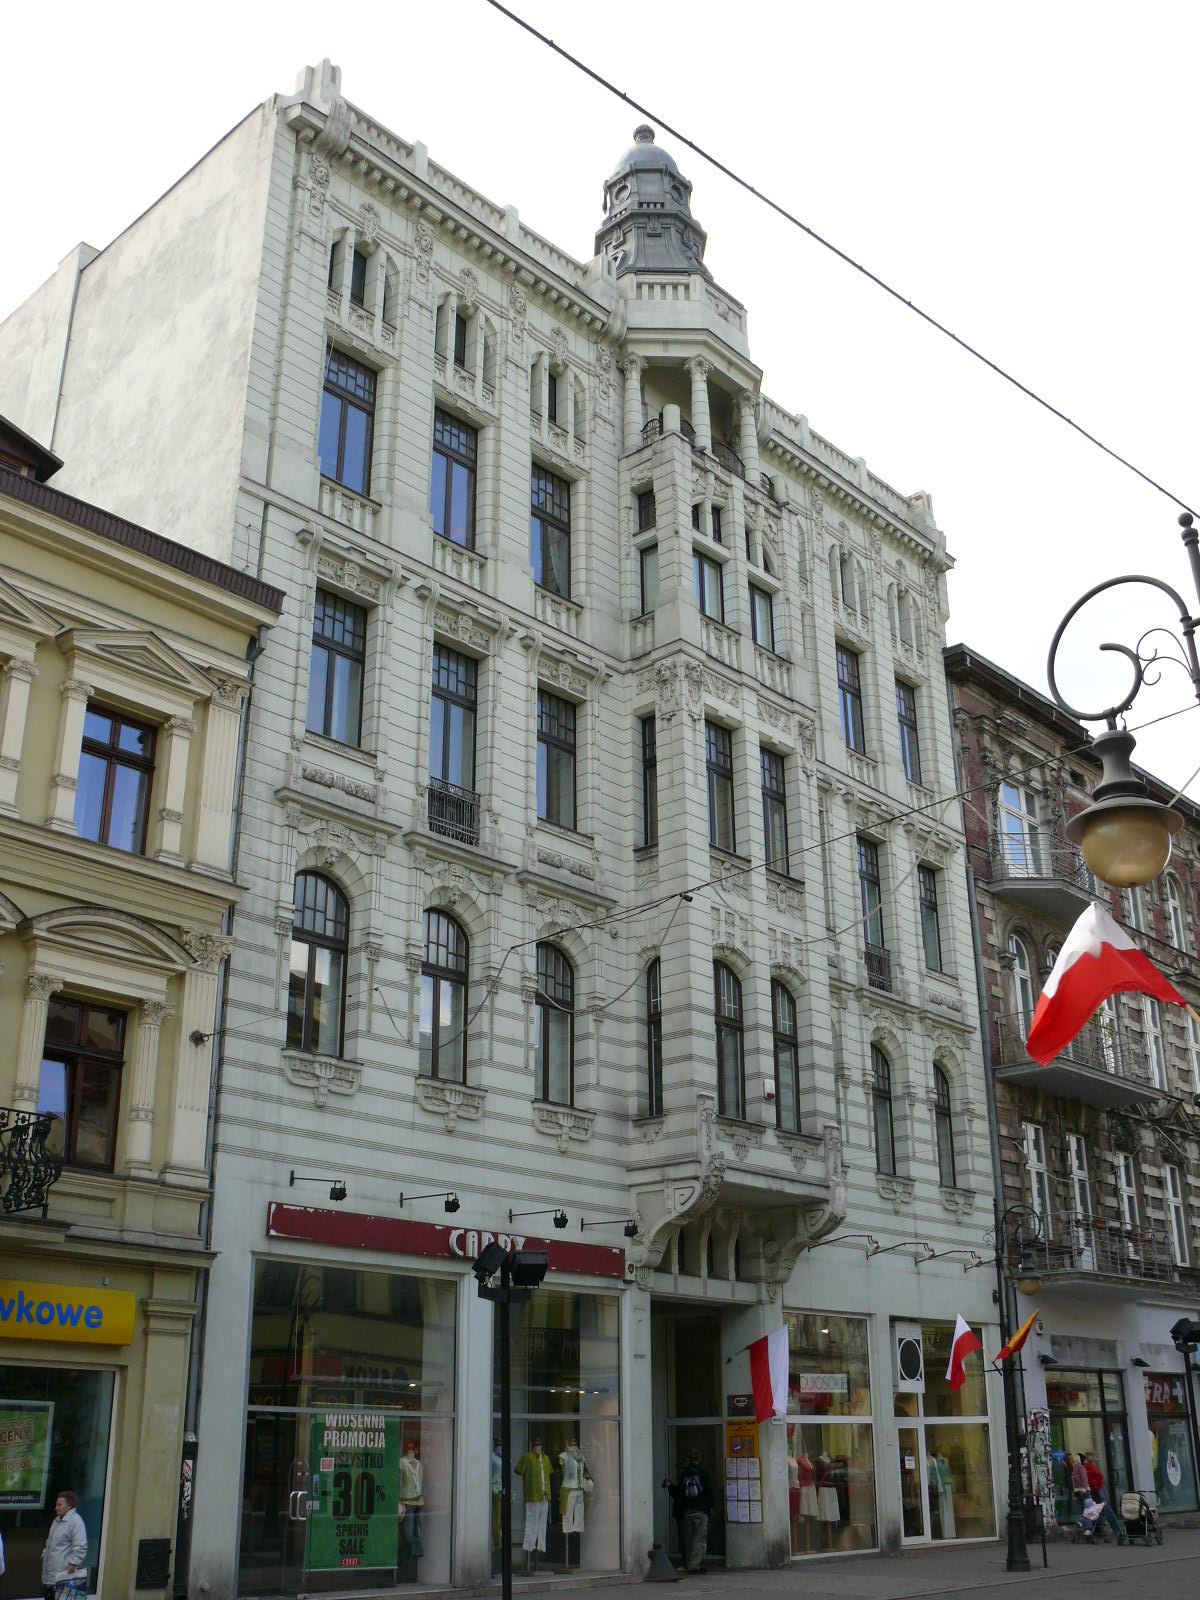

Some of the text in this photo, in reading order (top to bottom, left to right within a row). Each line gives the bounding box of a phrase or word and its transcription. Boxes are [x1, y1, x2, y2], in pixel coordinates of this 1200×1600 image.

[323, 1430, 386, 1448] PROMOCJA
[336, 1523, 369, 1537] SPRING
[339, 1539, 365, 1555] SALE
